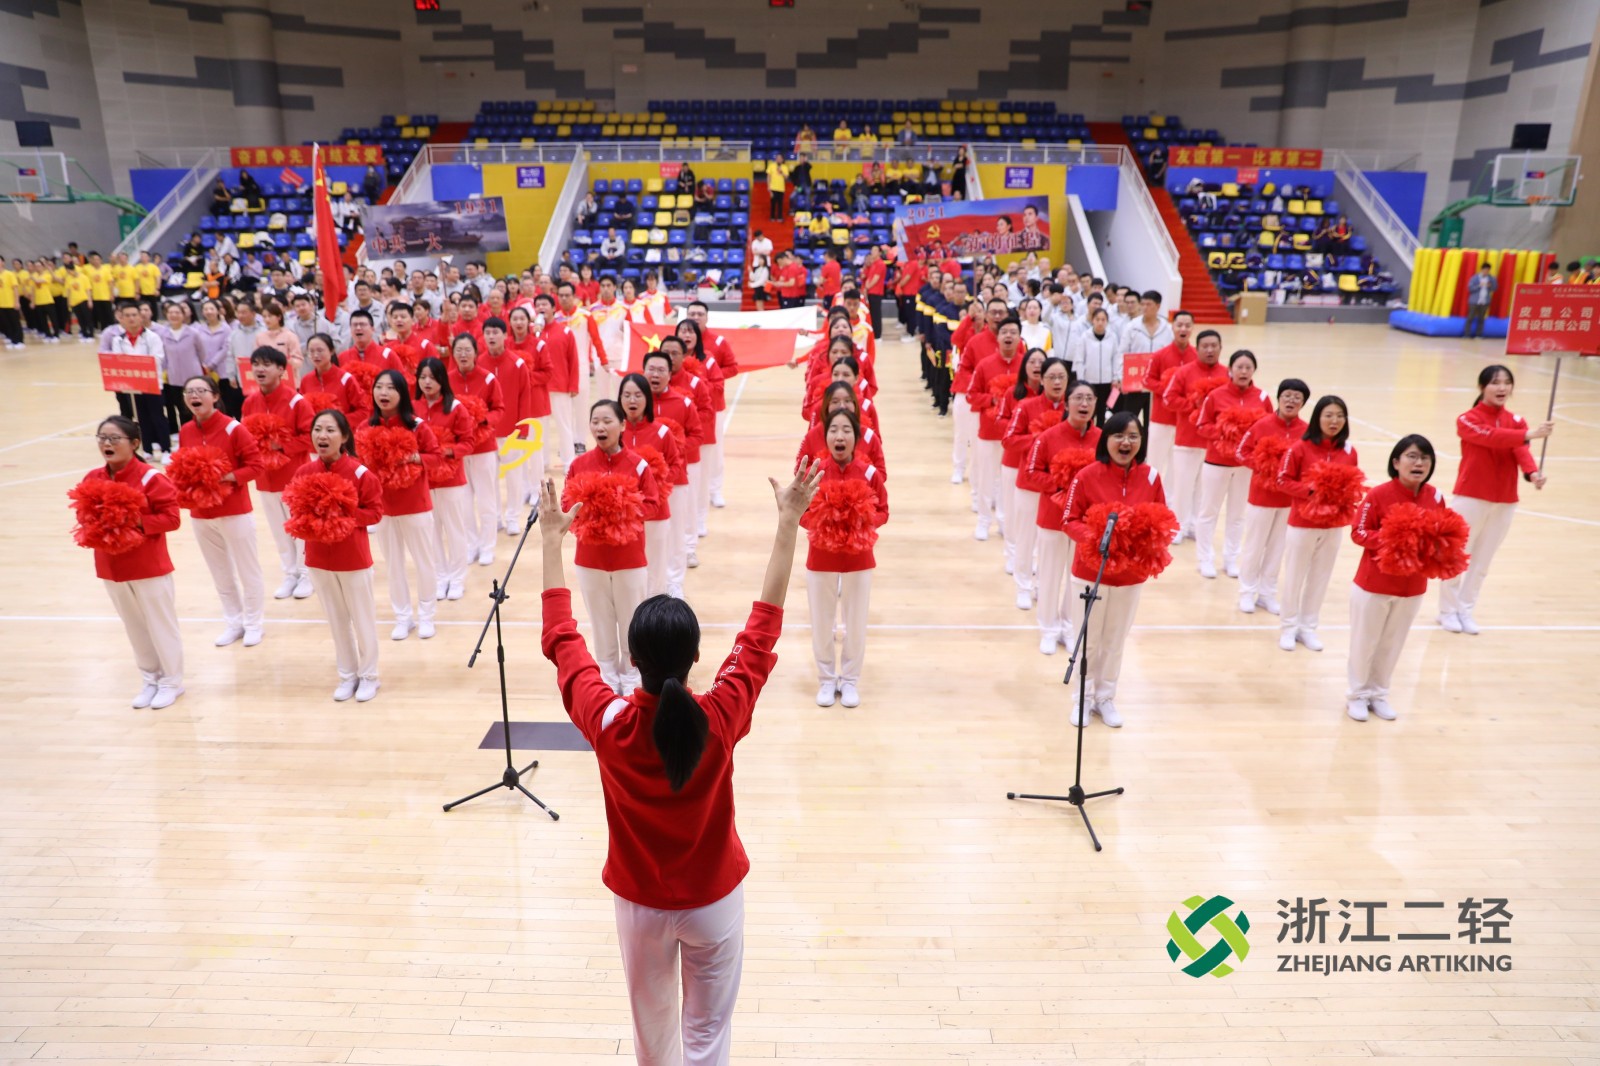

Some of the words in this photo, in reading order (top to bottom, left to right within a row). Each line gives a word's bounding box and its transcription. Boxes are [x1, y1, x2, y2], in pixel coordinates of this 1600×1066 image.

[1176, 148, 1241, 165] 友谊第一
[1252, 150, 1316, 167] 比赛第二
[454, 199, 498, 215] 1921
[907, 205, 945, 220] 2021
[371, 232, 443, 255] 中共一大
[1517, 319, 1592, 332] 建设租赁公司
